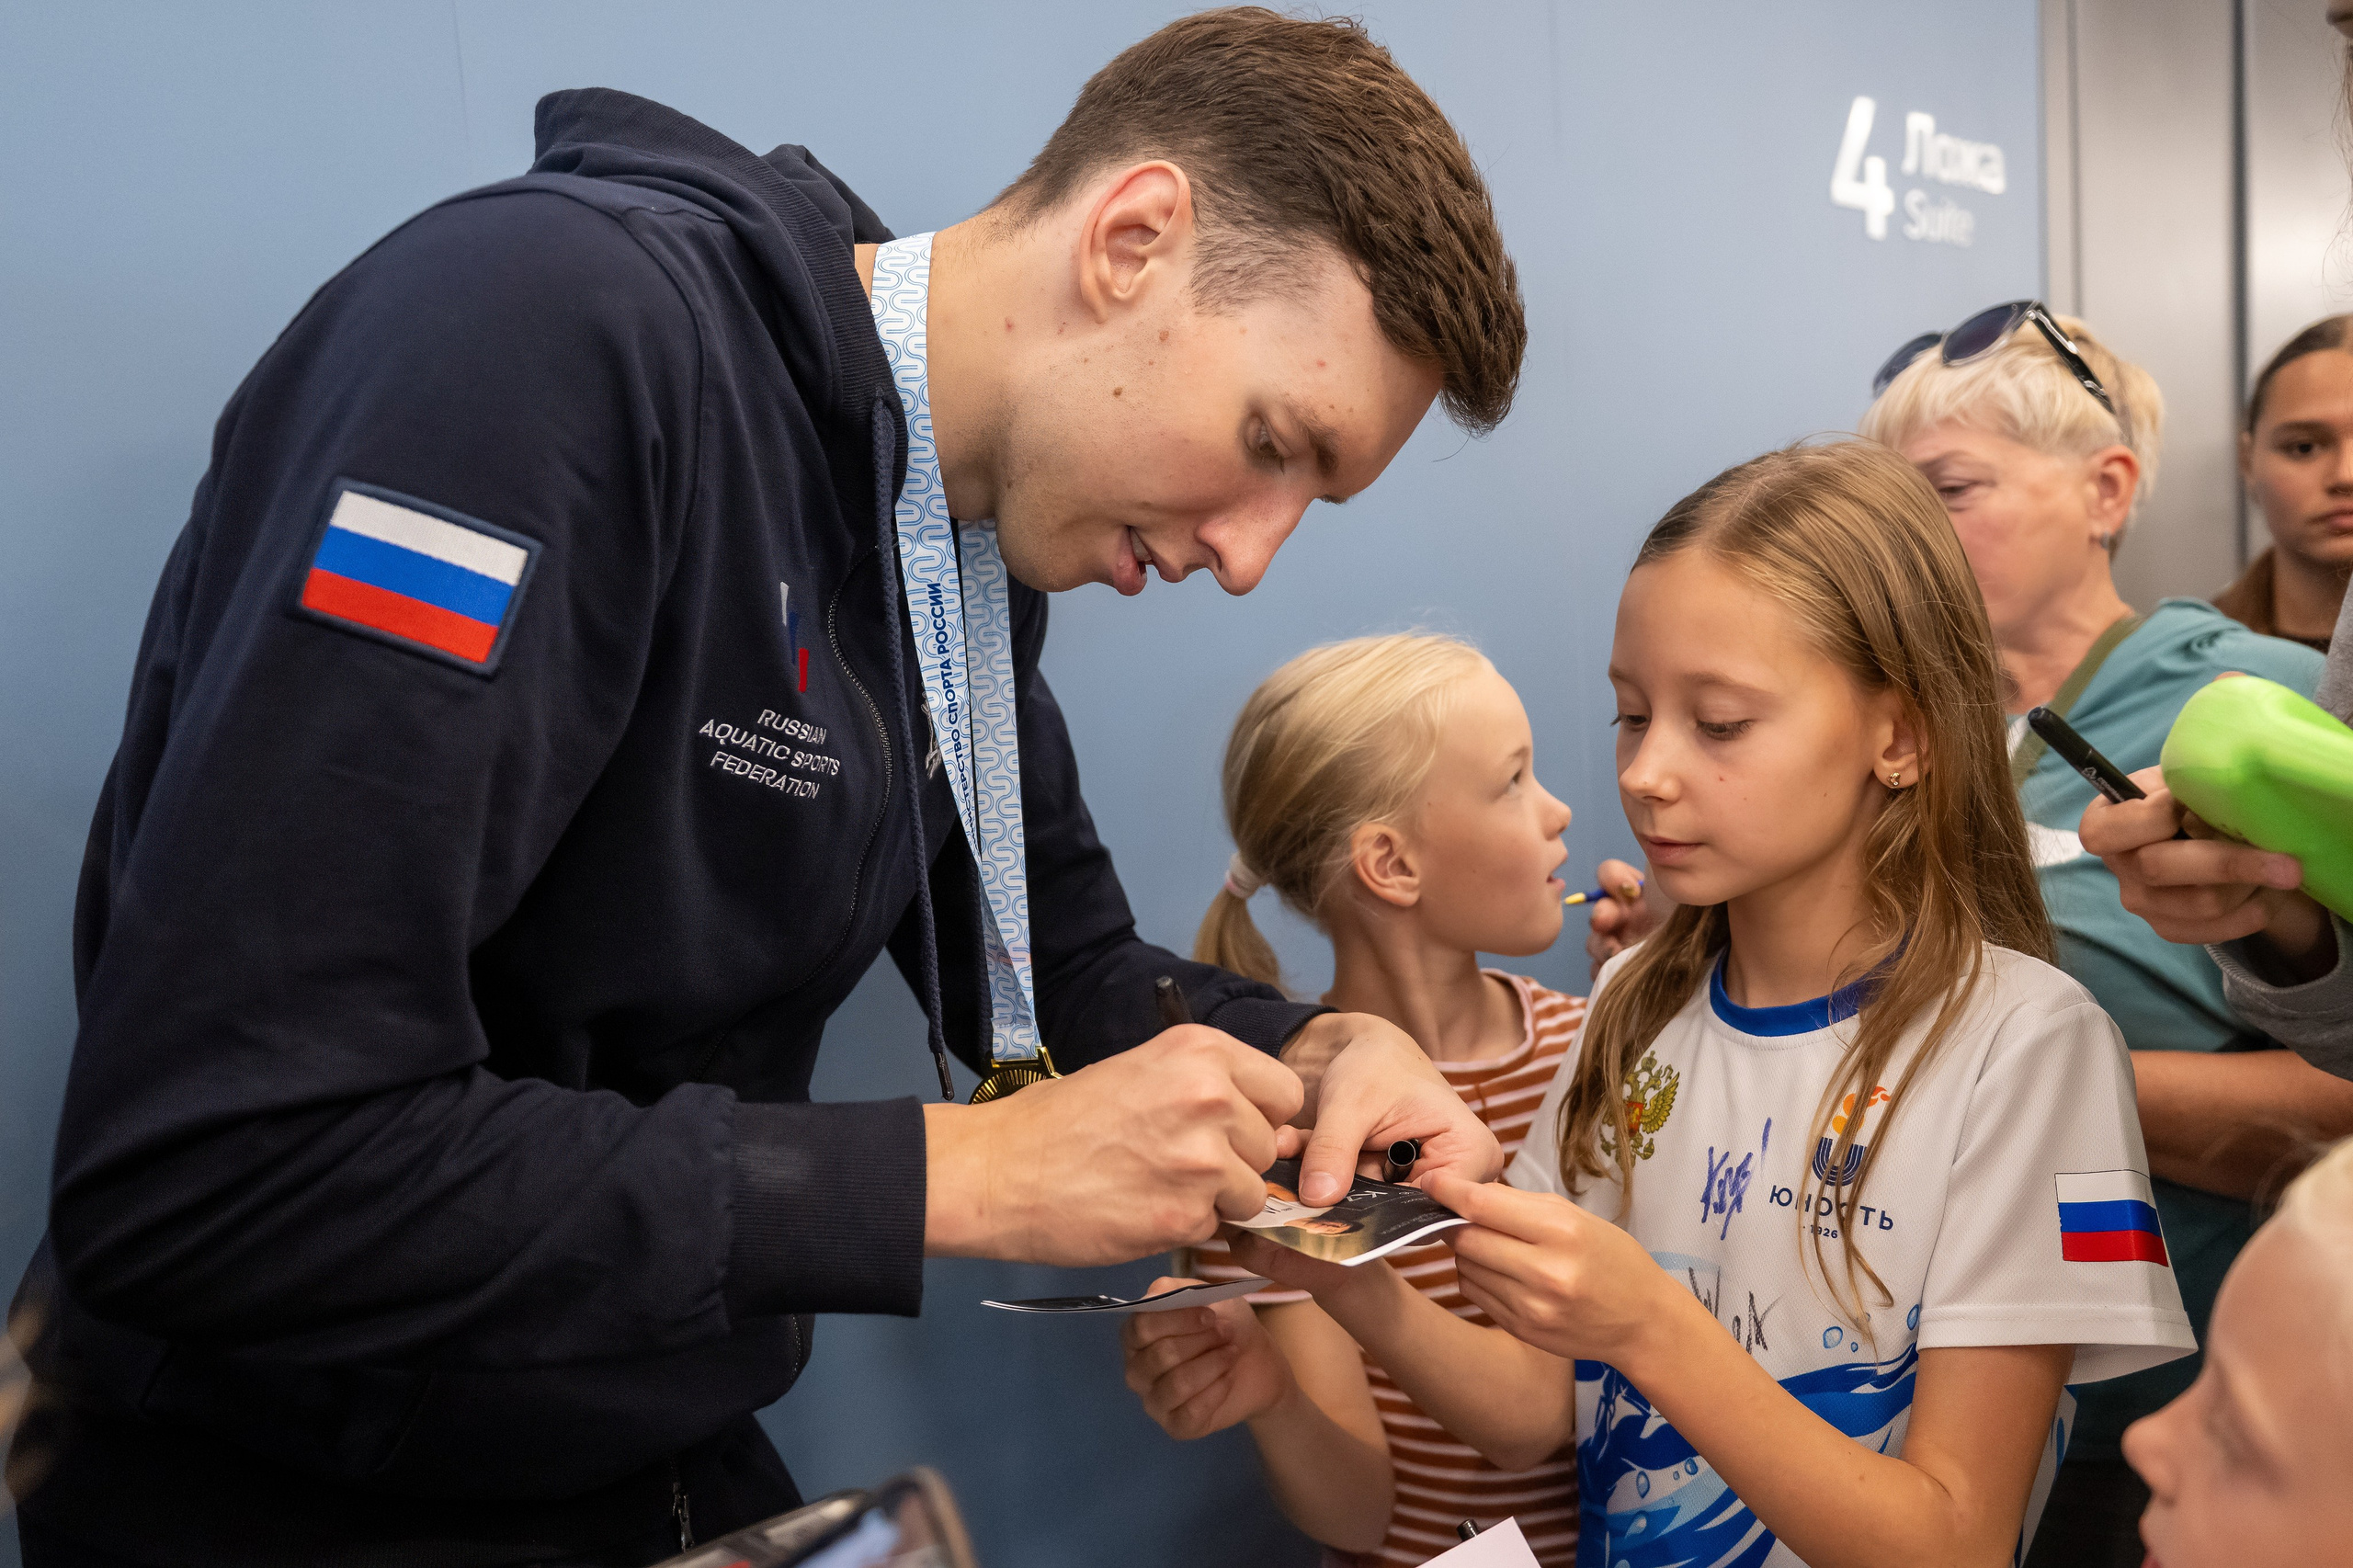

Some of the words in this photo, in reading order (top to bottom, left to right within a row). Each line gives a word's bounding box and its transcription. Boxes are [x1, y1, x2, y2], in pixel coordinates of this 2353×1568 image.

[1831, 96, 1895, 242] 4
[926, 582, 950, 655] РОССИИ
[939, 658, 959, 724] СПОРТА
[699, 719, 790, 760] AQUATIC
[790, 750, 840, 776] SPORTS
[757, 709, 827, 745] RUSSIAN
[710, 750, 820, 800] FEDERATION
